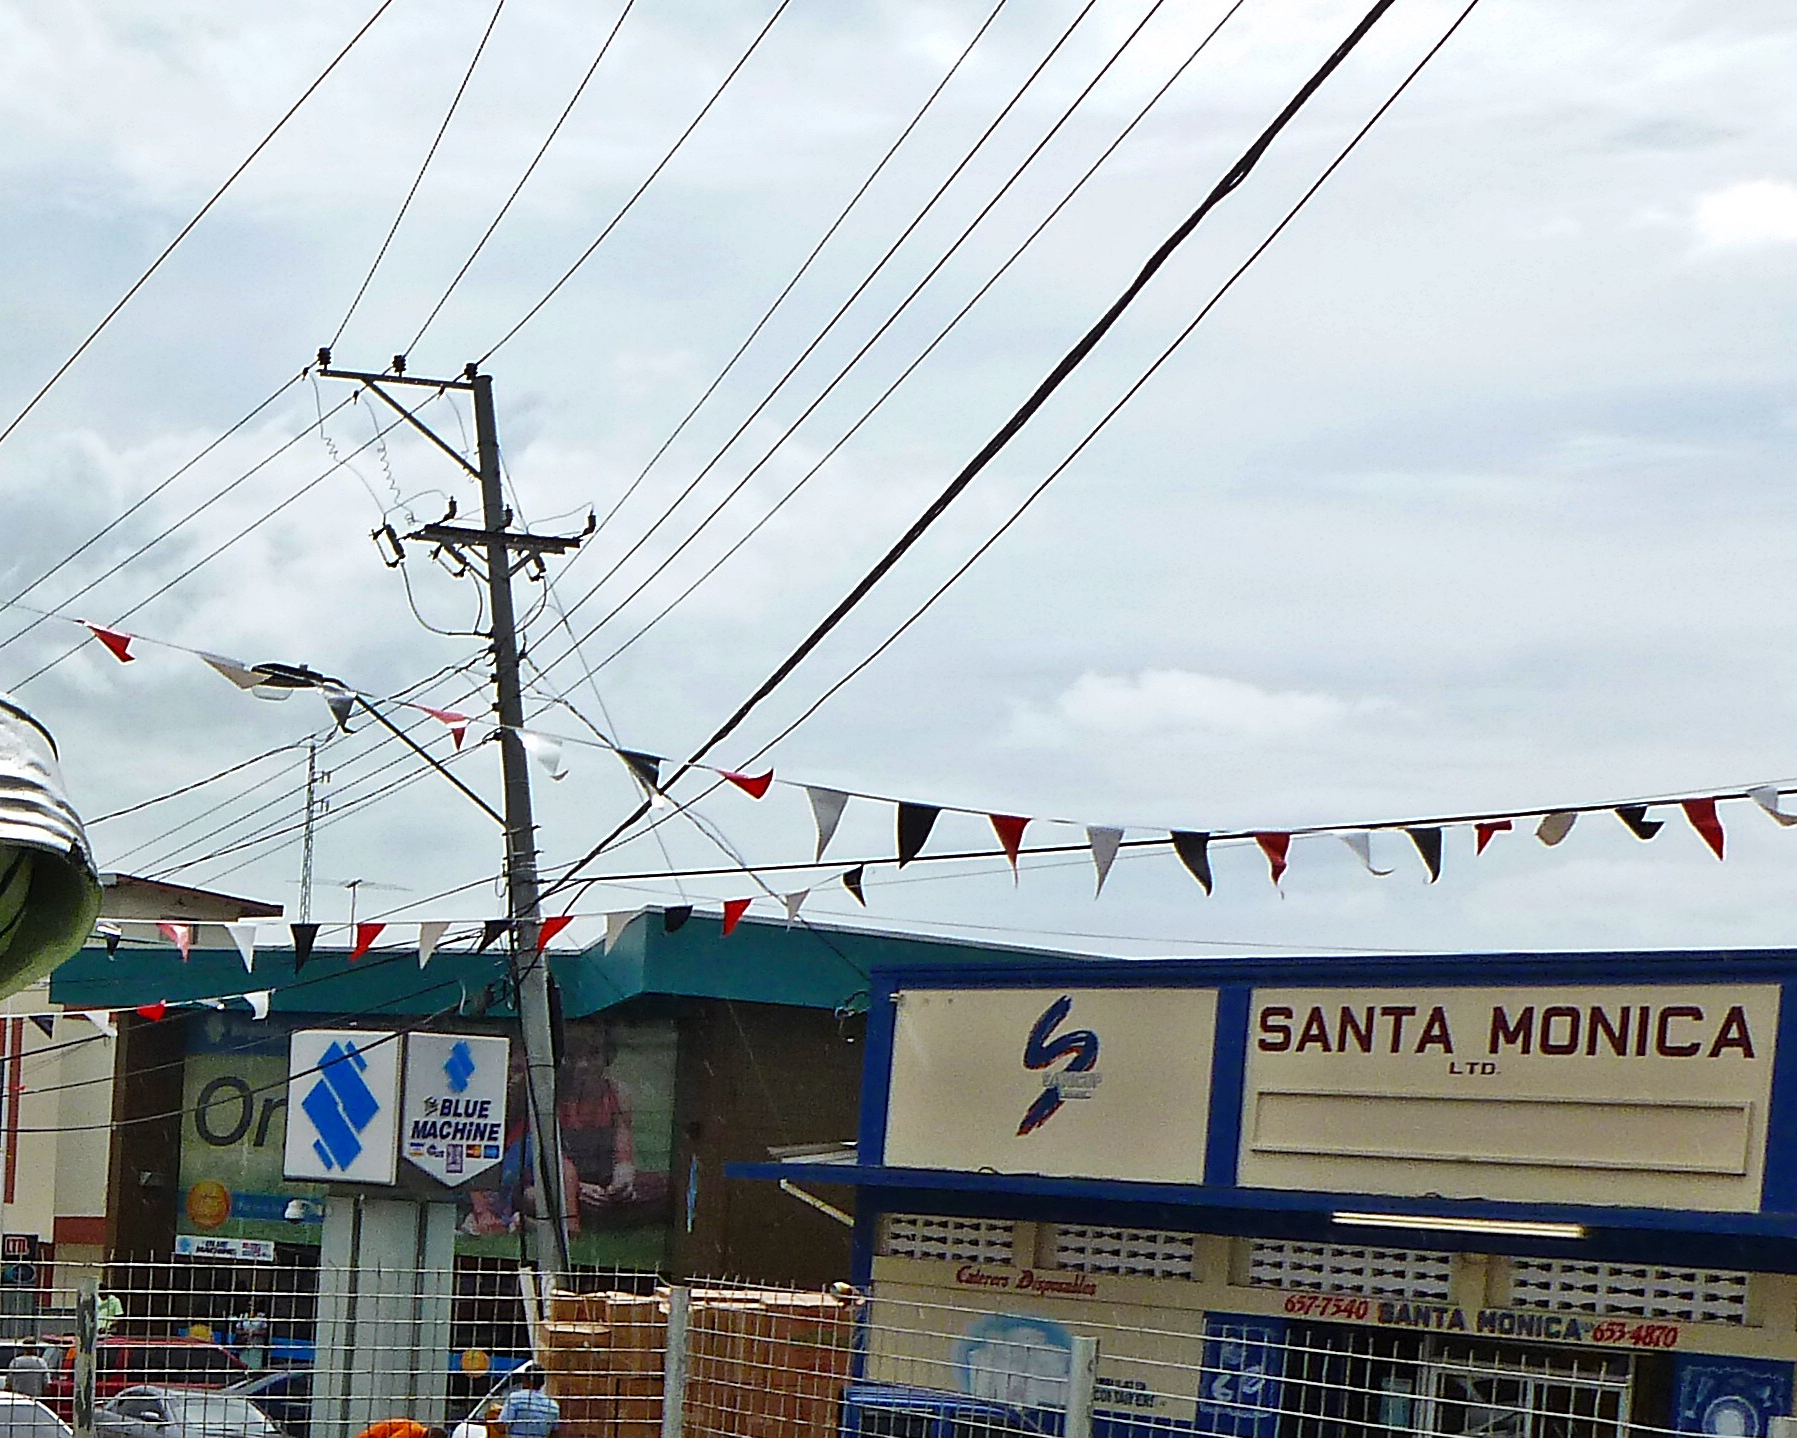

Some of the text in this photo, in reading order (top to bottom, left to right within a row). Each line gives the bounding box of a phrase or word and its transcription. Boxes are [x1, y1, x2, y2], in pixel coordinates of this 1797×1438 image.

[1258, 1005, 1755, 1058] SANTA MONICA
[439, 1098, 492, 1119] BLUE
[1284, 1295, 1679, 1348] 657-7540 SANTA MONICA 653-4870
